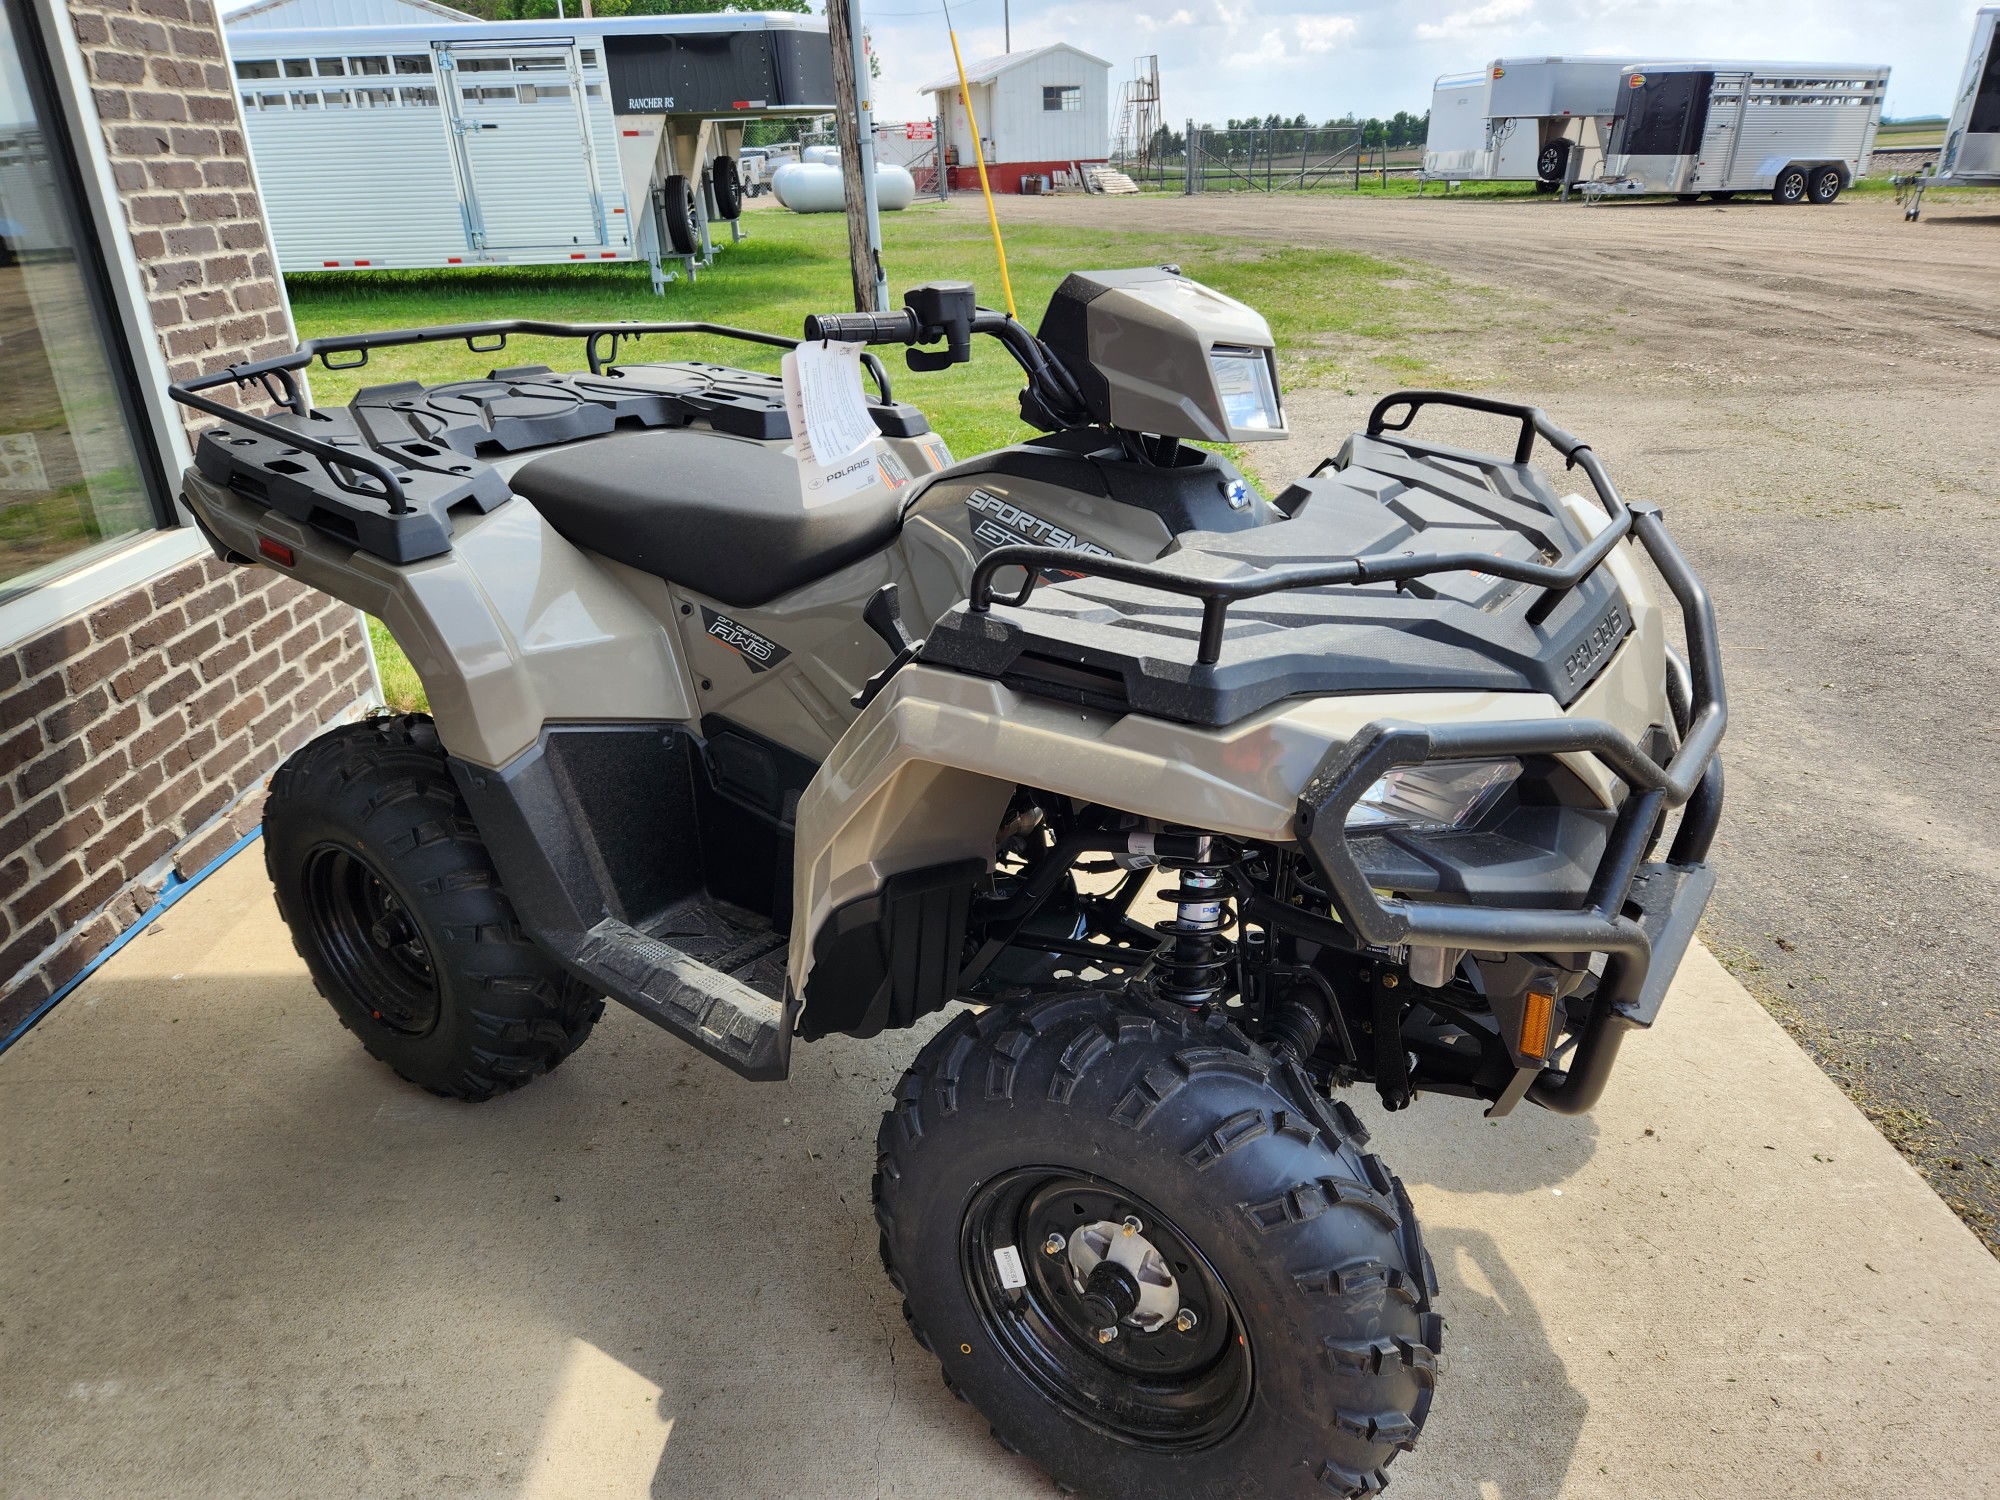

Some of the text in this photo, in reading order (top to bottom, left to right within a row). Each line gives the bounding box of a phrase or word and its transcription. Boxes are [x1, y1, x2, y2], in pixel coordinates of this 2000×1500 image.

[629, 97, 675, 109] RANCHER RS
[826, 458, 870, 483] POLARIS
[965, 488, 1117, 560] SPORTSMA
[708, 621, 772, 661] AWD
[1563, 605, 1623, 686] POLARIS
